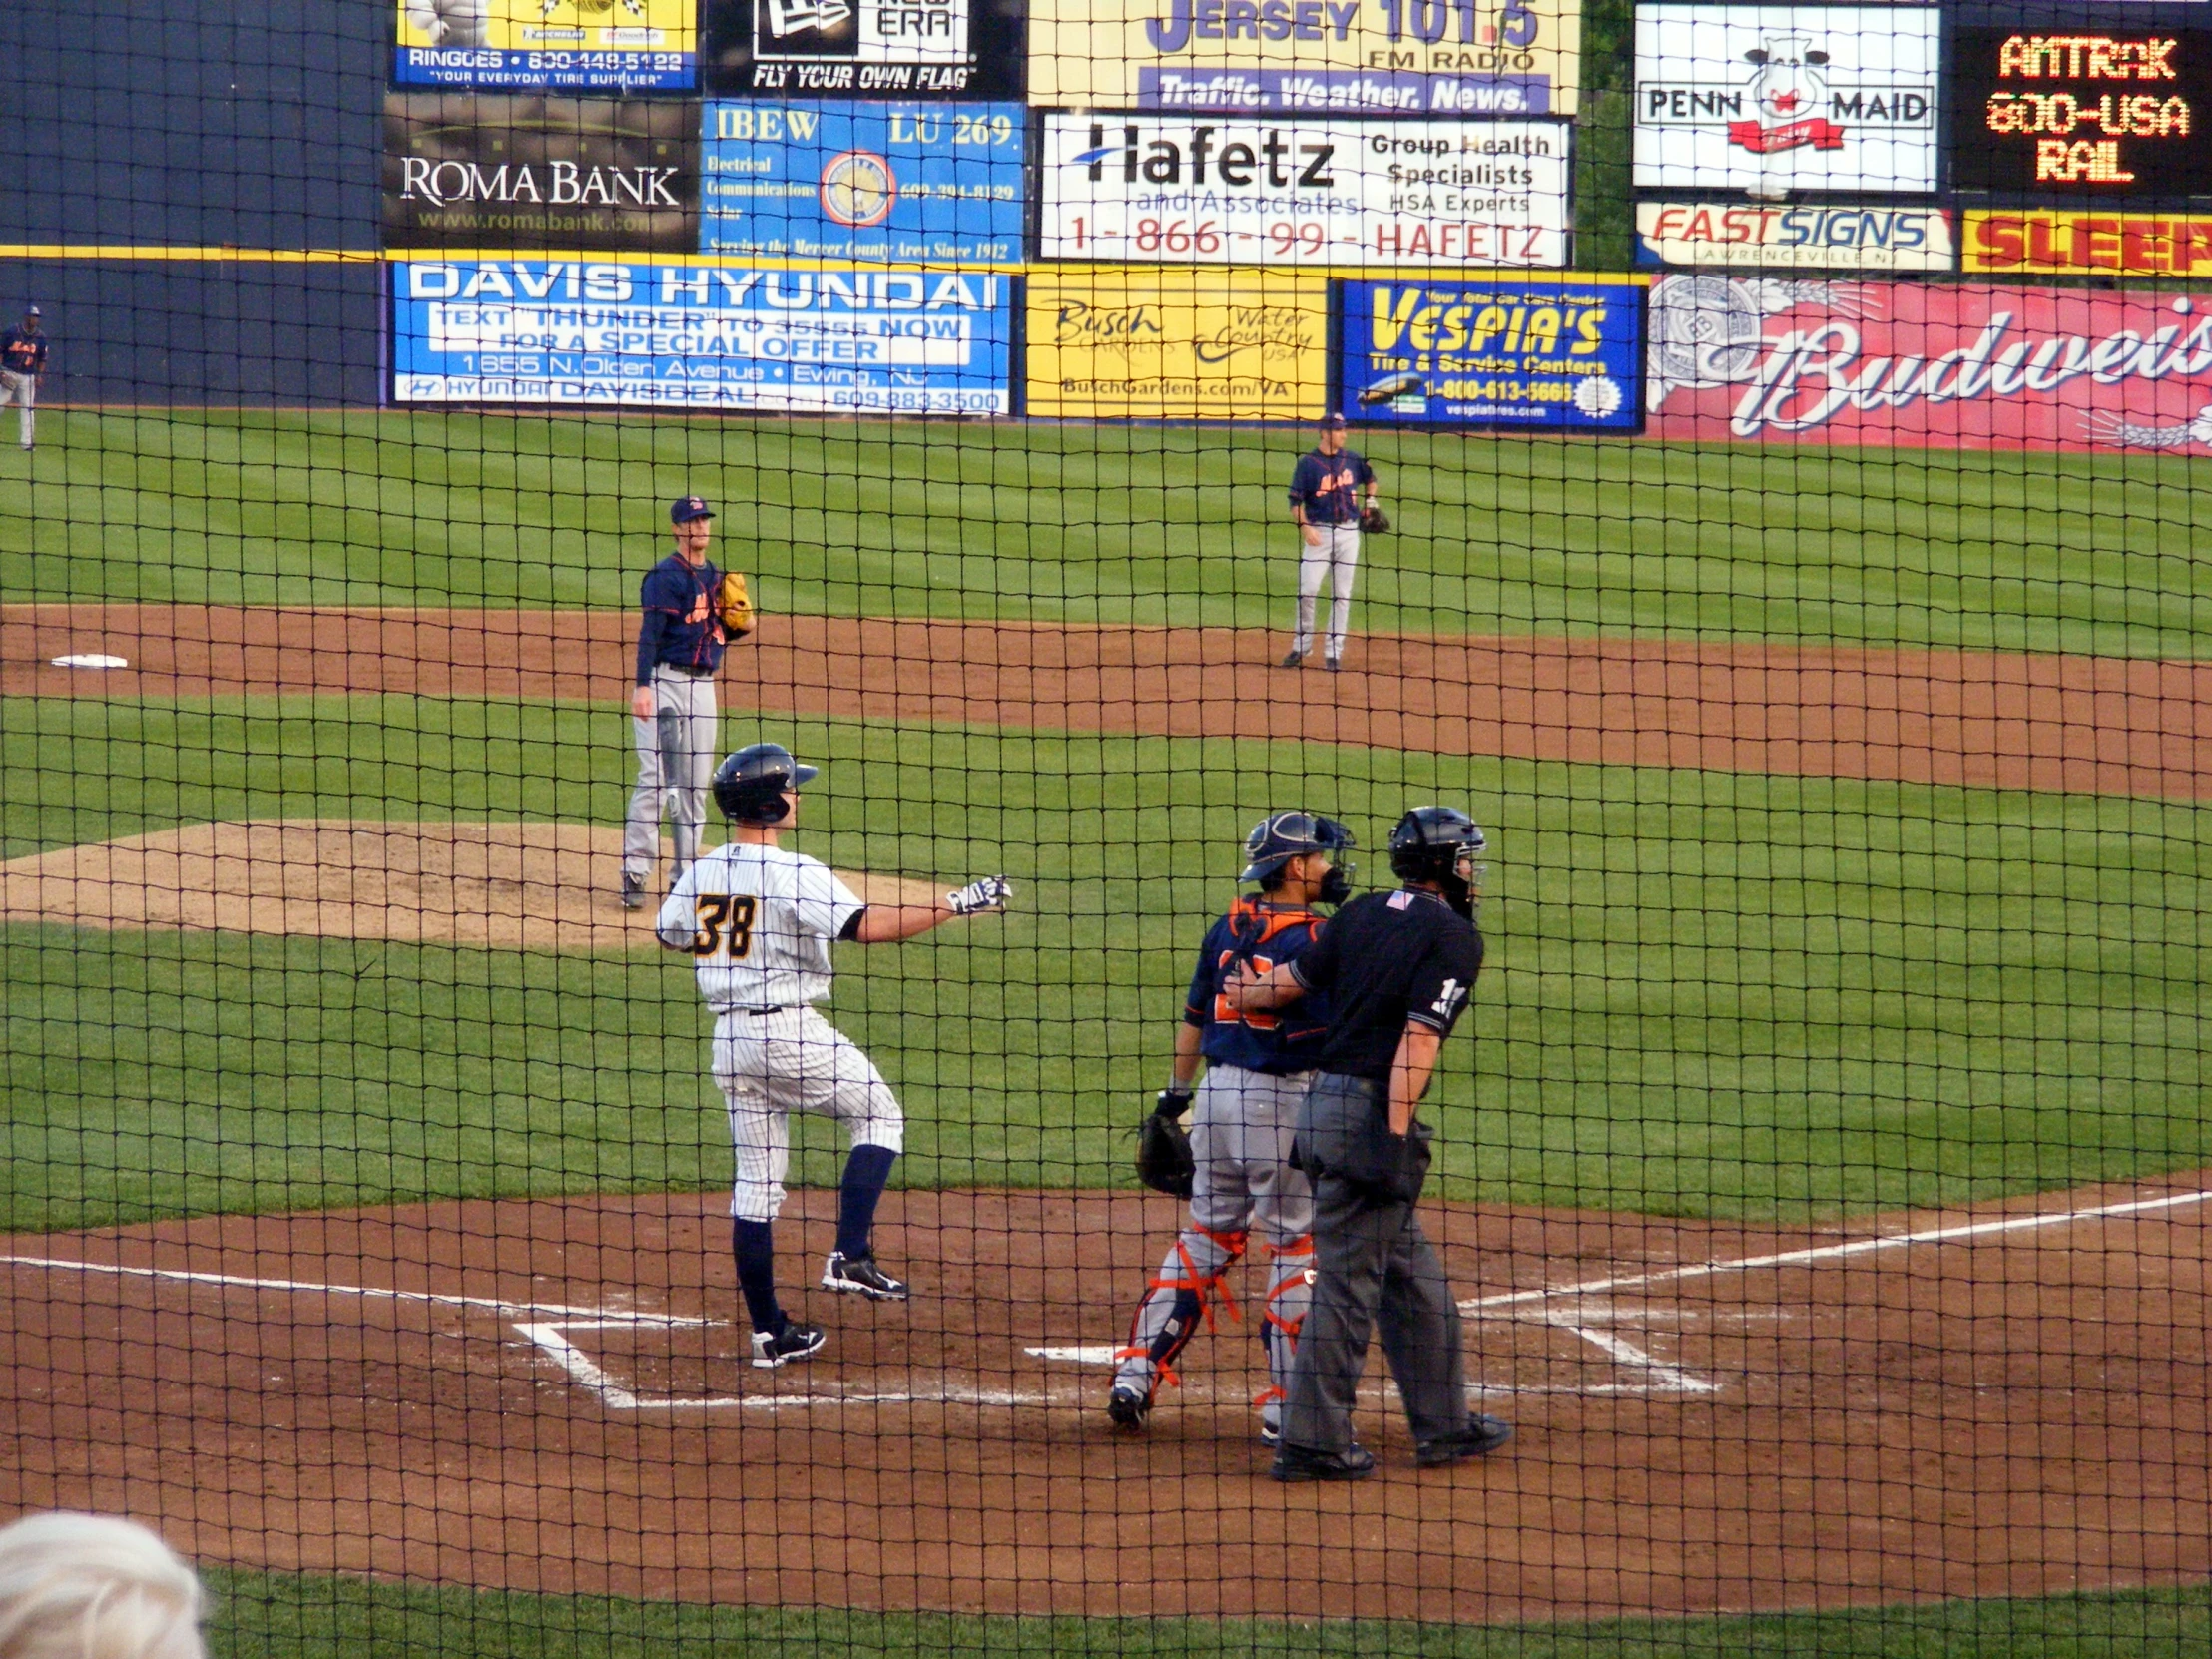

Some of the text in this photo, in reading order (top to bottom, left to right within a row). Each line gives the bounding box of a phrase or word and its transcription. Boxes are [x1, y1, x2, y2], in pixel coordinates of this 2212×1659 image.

[877, 9, 950, 37] ERA
[1145, 0, 1538, 53] JERSEY 101.5
[409, 49, 502, 68] RINGOES
[1369, 51, 1535, 71] FM RADIO
[1999, 35, 2177, 79] AMTRAK
[478, 72, 549, 83] EVERYDAY
[554, 73, 584, 84] TIRE
[753, 64, 968, 90] FLY YOUR OWN FLAG
[1158, 75, 1529, 112] Traffic. Weather. News.
[1650, 90, 1927, 121] PENN MAID
[716, 108, 1012, 146] IBEW LU 269
[1986, 92, 2190, 137] 800-USA
[1087, 124, 1334, 187] Hafetz
[1372, 135, 1549, 158] Group Health
[707, 156, 771, 172] Electrical
[2035, 139, 2135, 182] RAIL
[400, 157, 680, 207] ROMA BANK
[1387, 163, 1533, 187] Specialists
[707, 182, 817, 198] Communications
[1137, 189, 1358, 215] and Associates
[707, 205, 742, 220] Solar
[1390, 194, 1529, 214] HSA Experts
[417, 211, 659, 233] www.romabank.com
[1653, 208, 1926, 247] FASTSIGNS
[710, 238, 1008, 260] Serving the Mercer County Area Since 1912
[409, 263, 998, 312] DAVIS HYUNDAI
[436, 309, 513, 326] TEXT
[727, 317, 764, 332] TO
[879, 318, 962, 338] NOW
[1041, 298, 1166, 342] Busch
[1236, 307, 1310, 329] Water
[1372, 287, 1608, 355] VESPIA'S
[500, 332, 879, 360] FOR A SPECIAL OFFER
[1215, 325, 1313, 356] Country
[665, 360, 765, 381] Avenue
[794, 366, 877, 387] Ewing,
[890, 370, 925, 385] NJ
[1370, 352, 1608, 375] Tire & Service Centers
[448, 380, 549, 397] HYUNDAI
[1063, 377, 1289, 397] BuschGardens.com/VA
[694, 893, 756, 960] 38
